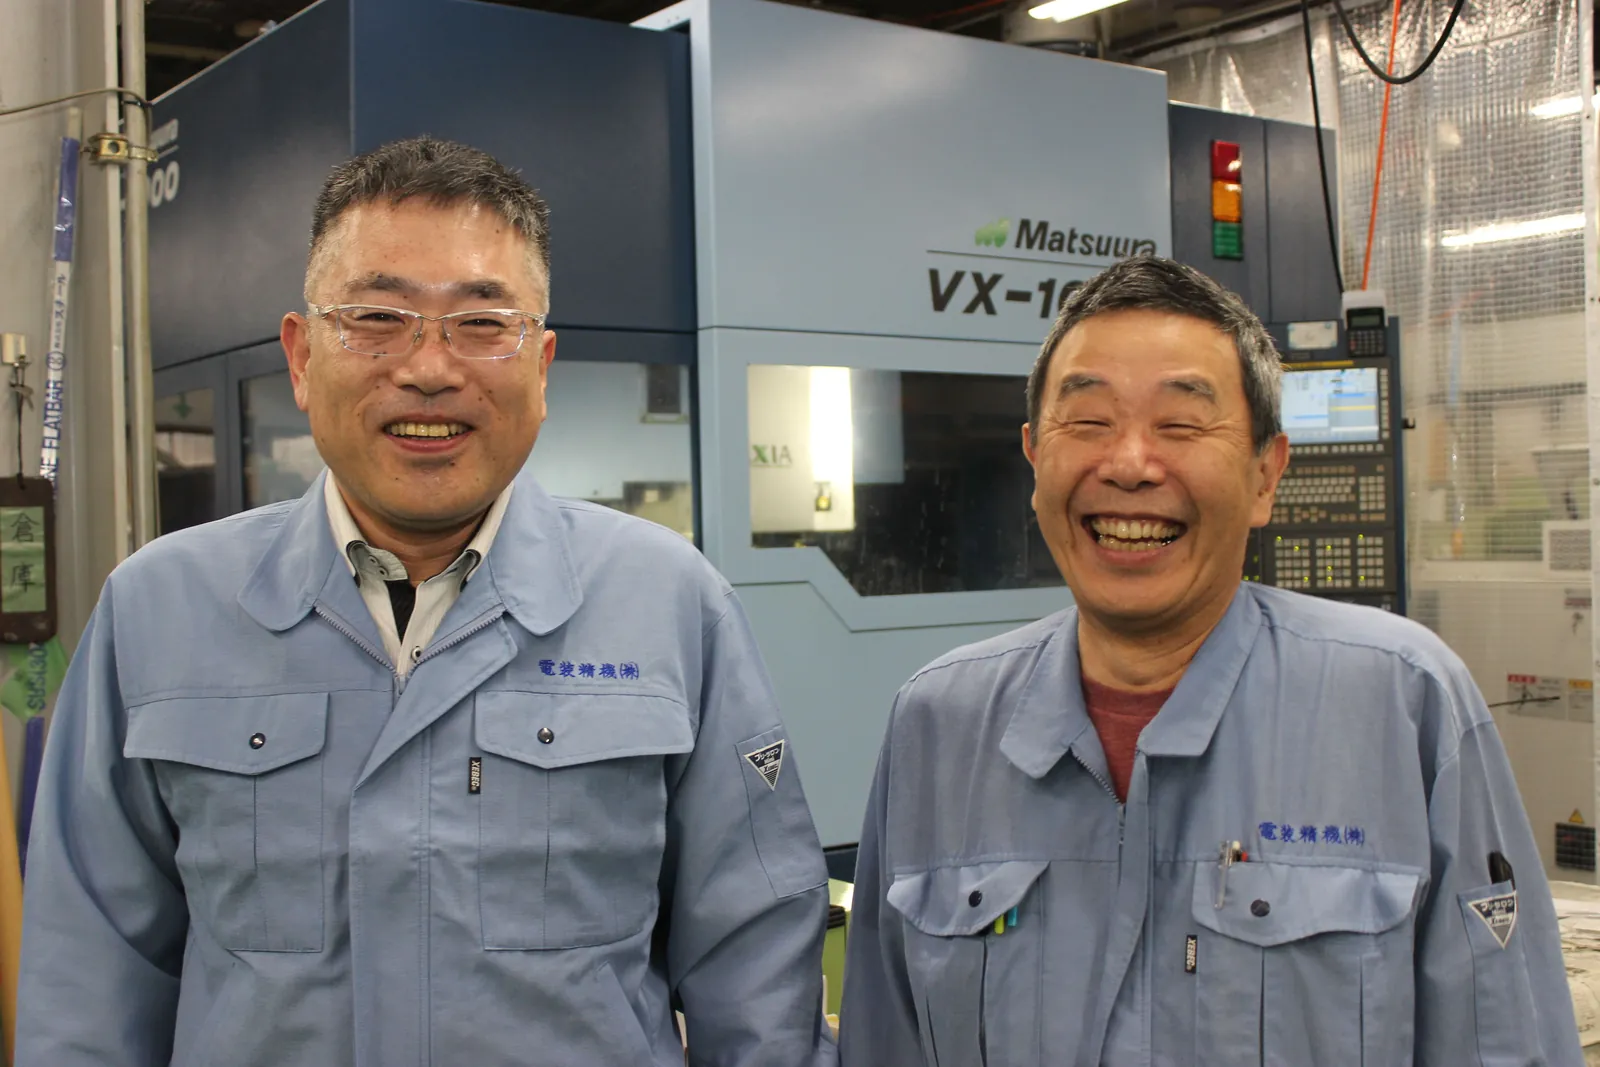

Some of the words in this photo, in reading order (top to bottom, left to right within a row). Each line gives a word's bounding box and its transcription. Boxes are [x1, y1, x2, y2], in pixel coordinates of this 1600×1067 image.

[1015, 218, 1157, 258] Matsuura
[11, 511, 40, 593] 倉庫
[471, 760, 481, 788] XEBEC
[1186, 937, 1196, 967] XEBEC
